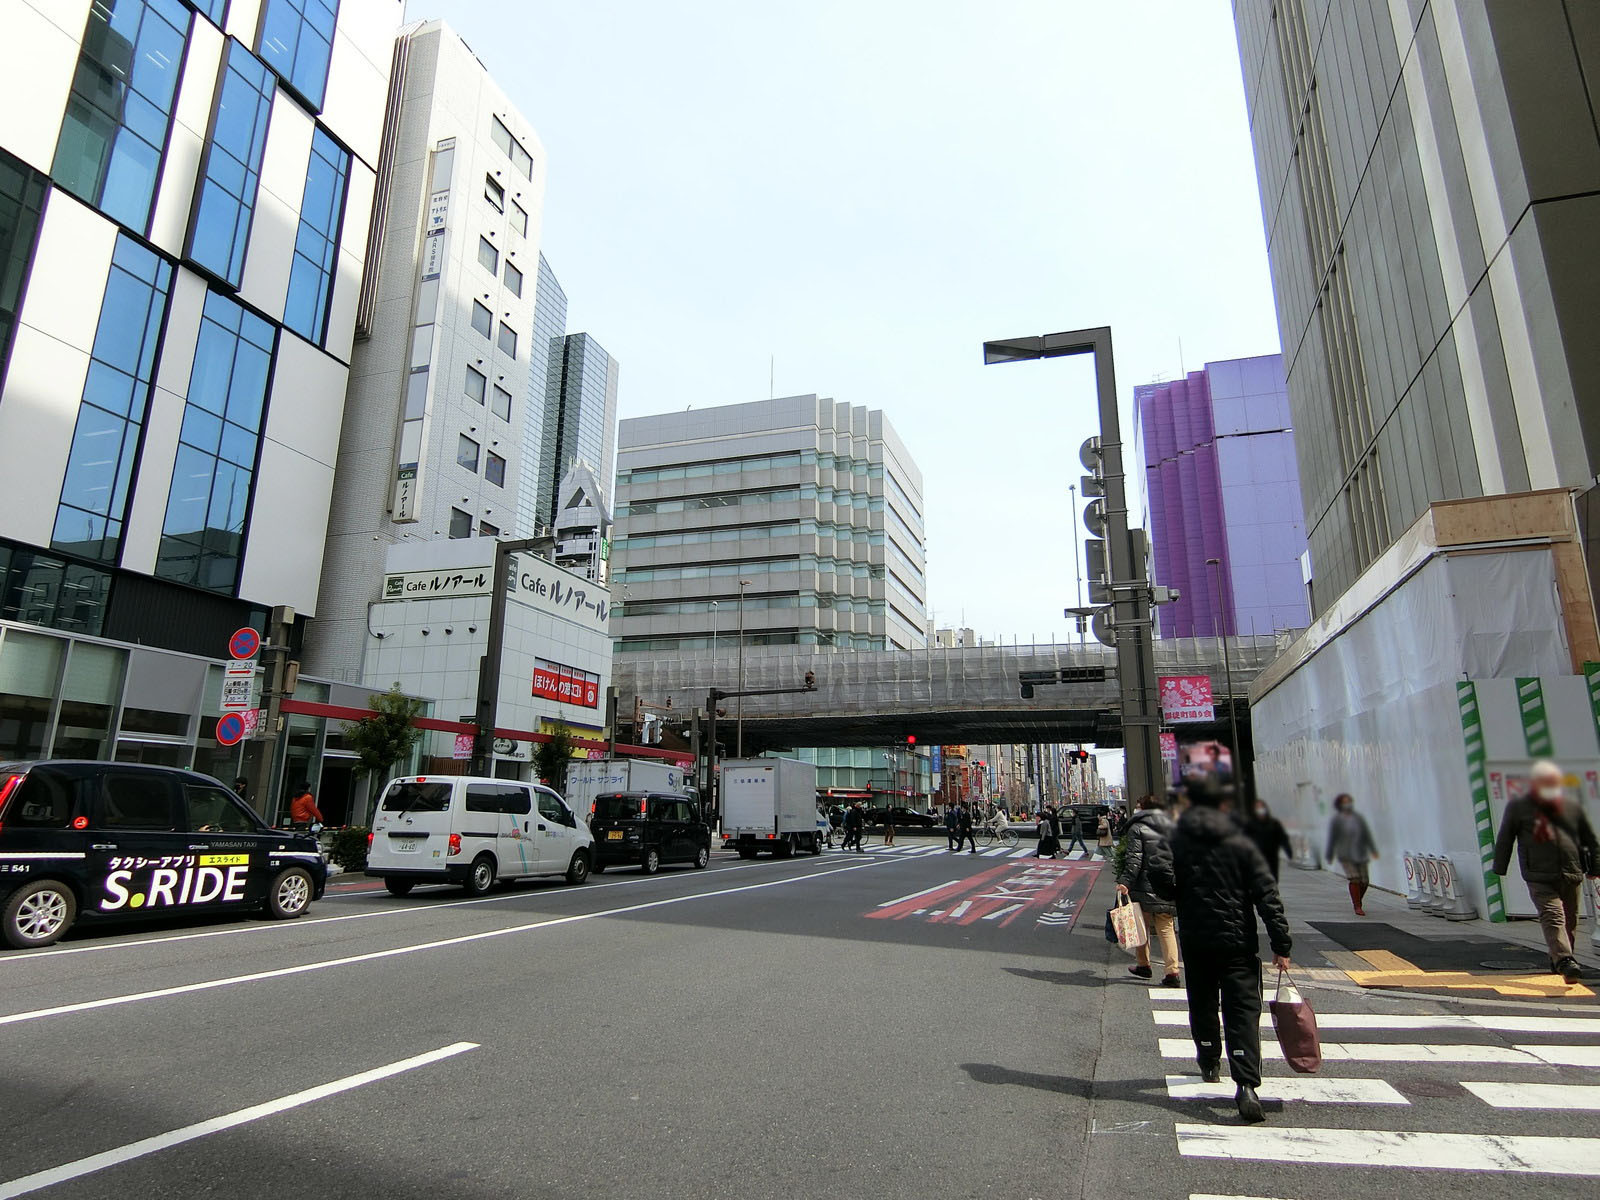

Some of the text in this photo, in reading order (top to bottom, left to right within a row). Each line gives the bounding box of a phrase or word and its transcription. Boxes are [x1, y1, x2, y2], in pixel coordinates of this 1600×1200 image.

[399, 481, 409, 518] ルノアール
[406, 573, 487, 591] Cafe ルノアール
[521, 573, 608, 622] Cafe ルノアール
[571, 776, 596, 784] ワールド
[109, 855, 195, 869] タクシーアプリ
[209, 856, 241, 864] エスライド
